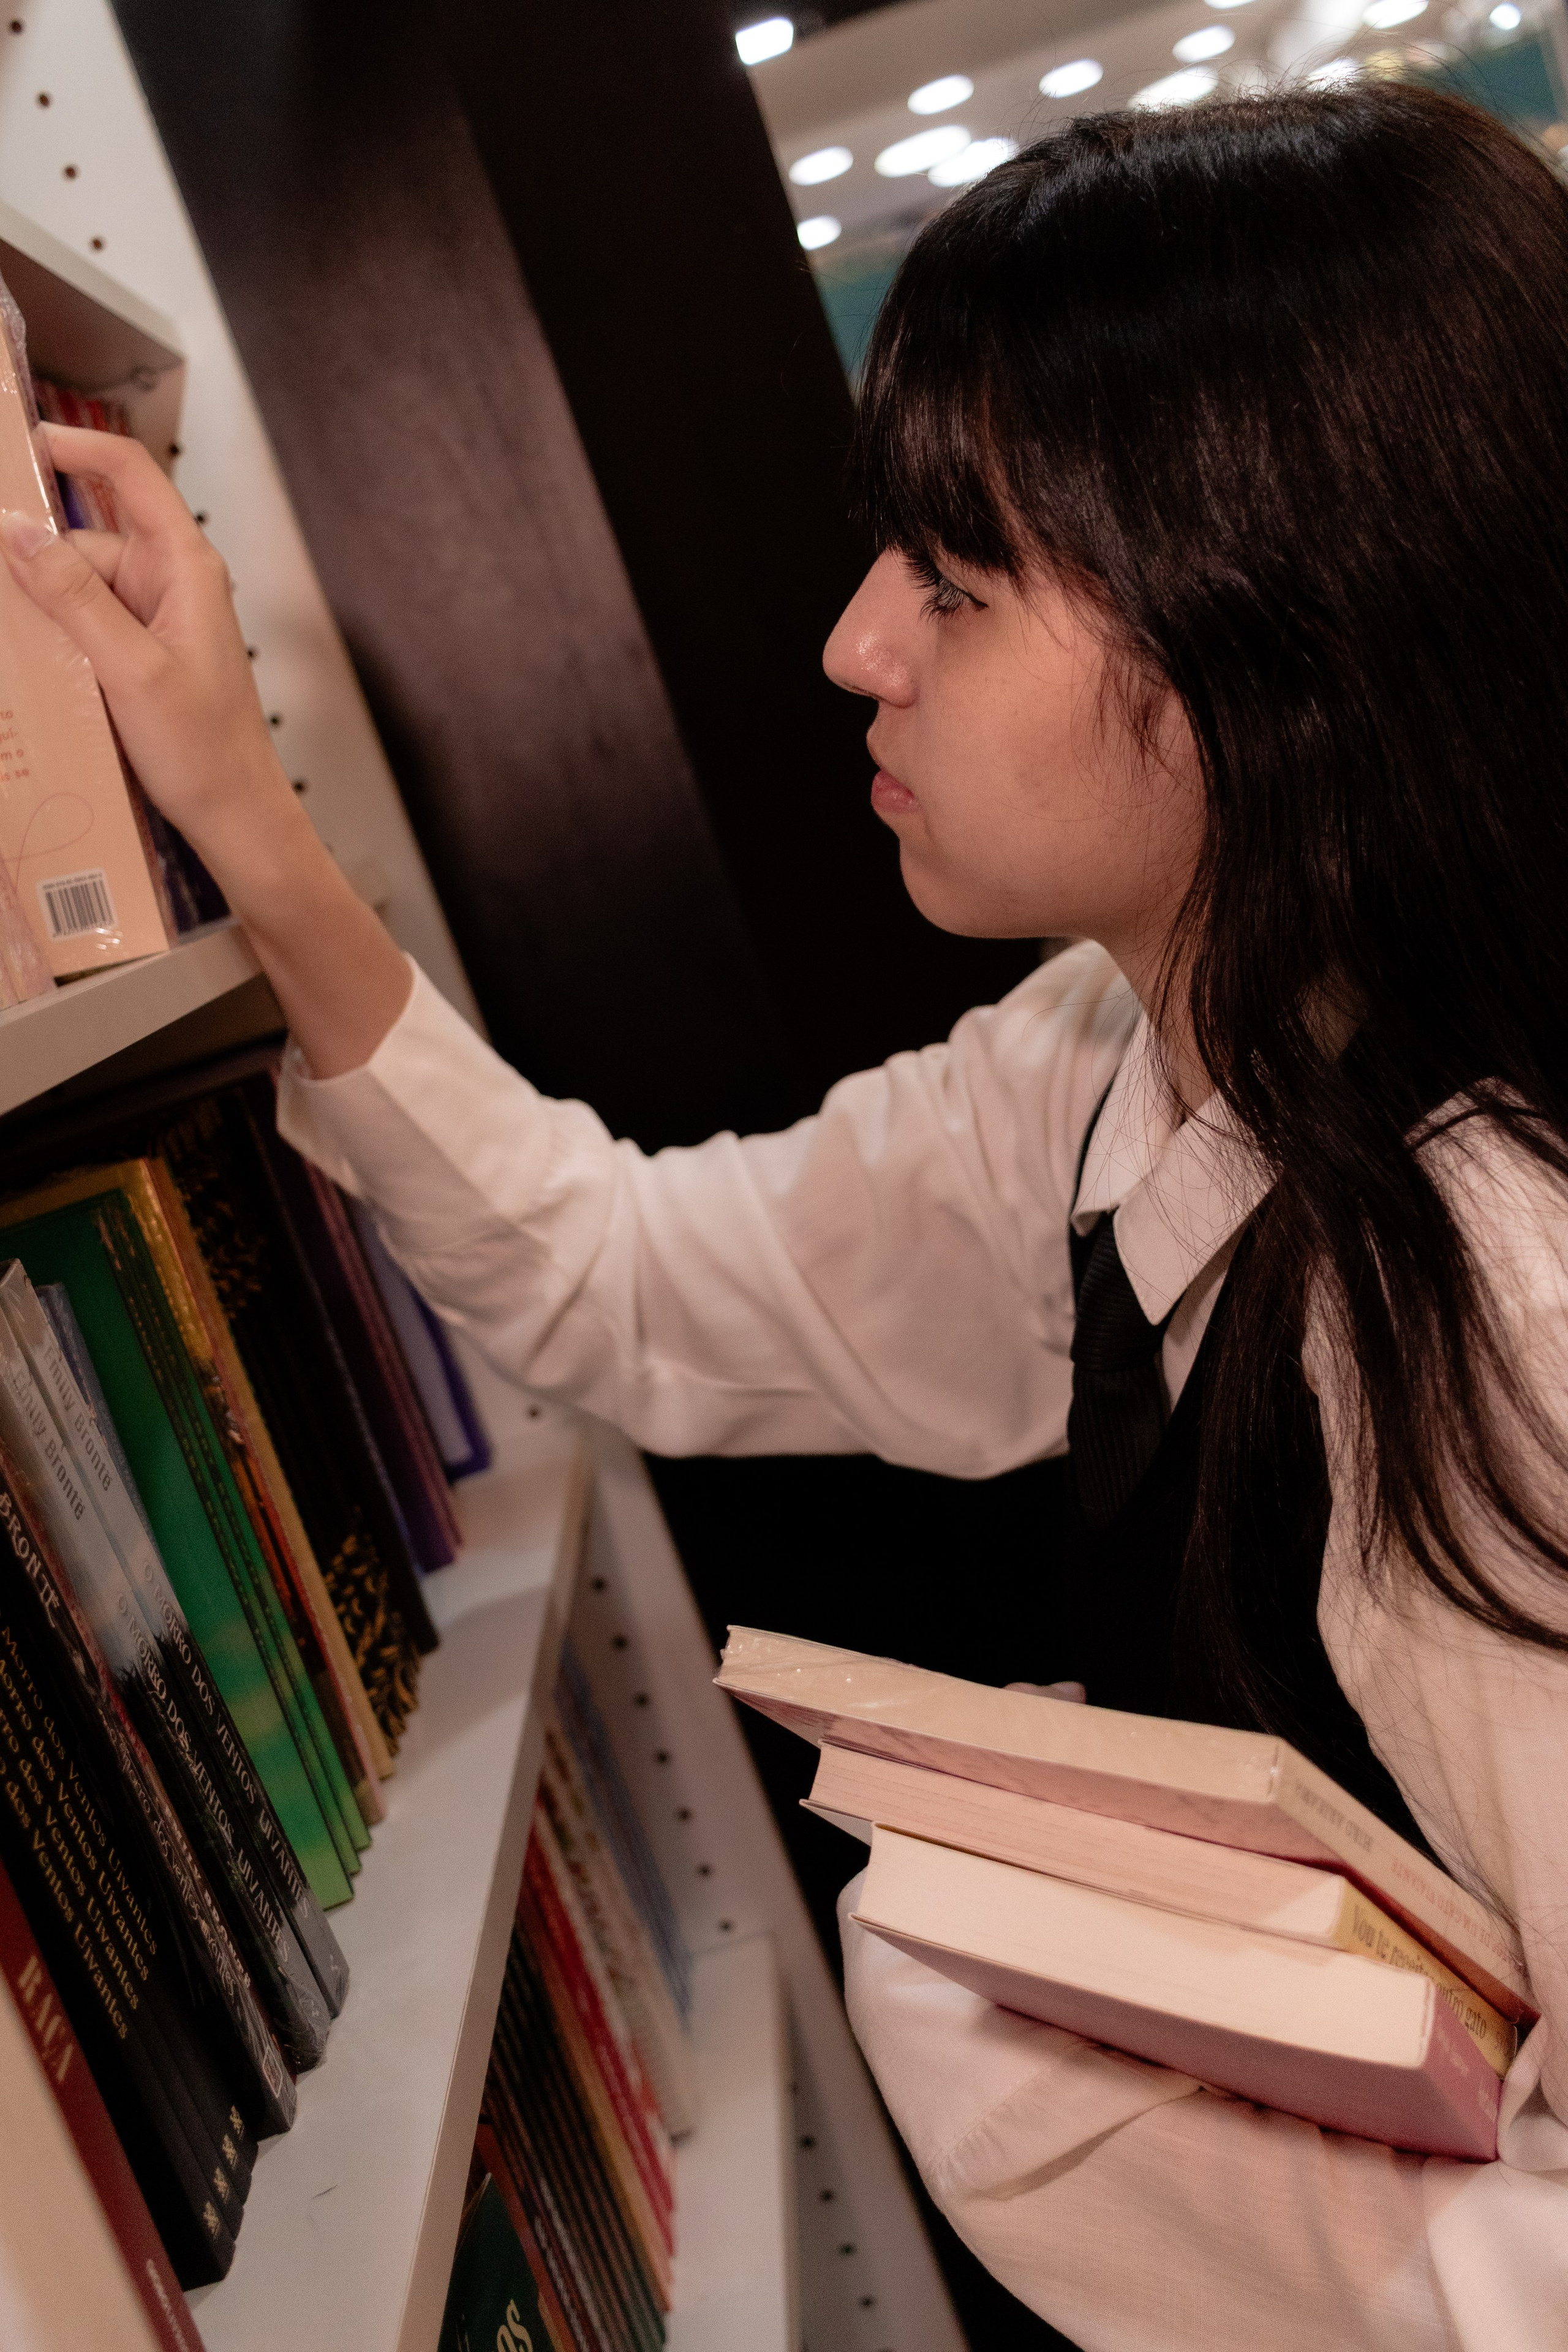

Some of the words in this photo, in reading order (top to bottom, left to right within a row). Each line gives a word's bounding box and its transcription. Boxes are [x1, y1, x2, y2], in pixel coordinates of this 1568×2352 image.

[12, 1373, 47, 1436] Emily
[45, 1439, 86, 1520] Brontë
[44, 1346, 76, 1412] Emily
[75, 1411, 113, 1491] Brontë
[32, 1736, 55, 1782] dos
[59, 1781, 97, 1870] Ventos
[99, 1870, 148, 1981] Uivantes
[44, 1716, 66, 1760] dos
[69, 1760, 107, 1847] Ventos
[109, 1847, 157, 1954] Uivantes
[129, 1615, 167, 1702] MORRO
[167, 1698, 191, 1753] DOS
[192, 1750, 235, 1838] VENTOS
[238, 1847, 289, 1962] UIVANTES
[155, 1582, 192, 1665] MORRO
[191, 1664, 214, 1716] DOS
[217, 1714, 257, 1804] VENTOS
[259, 1808, 308, 1918] UIVANTES
[5, 1781, 31, 1829] dos
[32, 1828, 74, 1923] Ventos
[74, 1921, 127, 2039] Uivantes
[19, 1758, 43, 1805] dos
[46, 1804, 86, 1898] Ventos
[87, 1897, 138, 2010] Uivantes
[1465, 2007, 1487, 2039] gato
